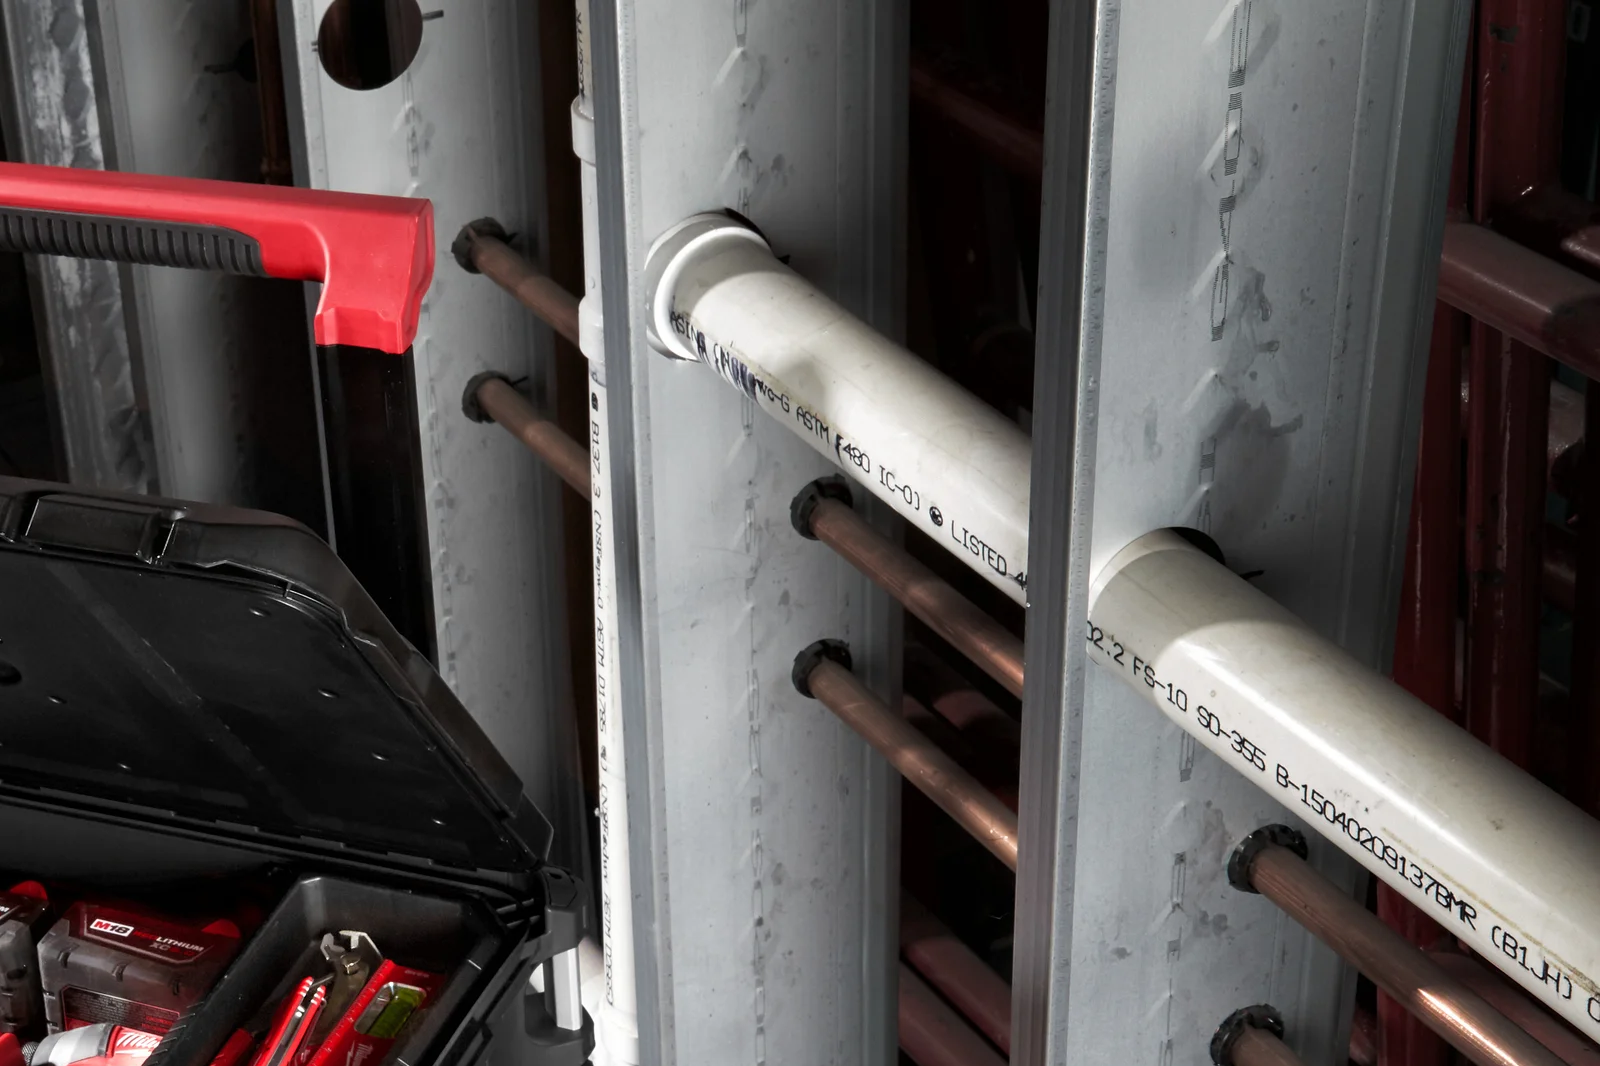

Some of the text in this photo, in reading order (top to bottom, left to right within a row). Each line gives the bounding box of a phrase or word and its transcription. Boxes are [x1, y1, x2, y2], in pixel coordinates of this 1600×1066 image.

[796, 405, 830, 443] ASTM
[951, 519, 1008, 576] LISTED
[1132, 656, 1188, 713] FS-10
[1196, 705, 1267, 772] SD-355
[93, 920, 131, 934] M18
